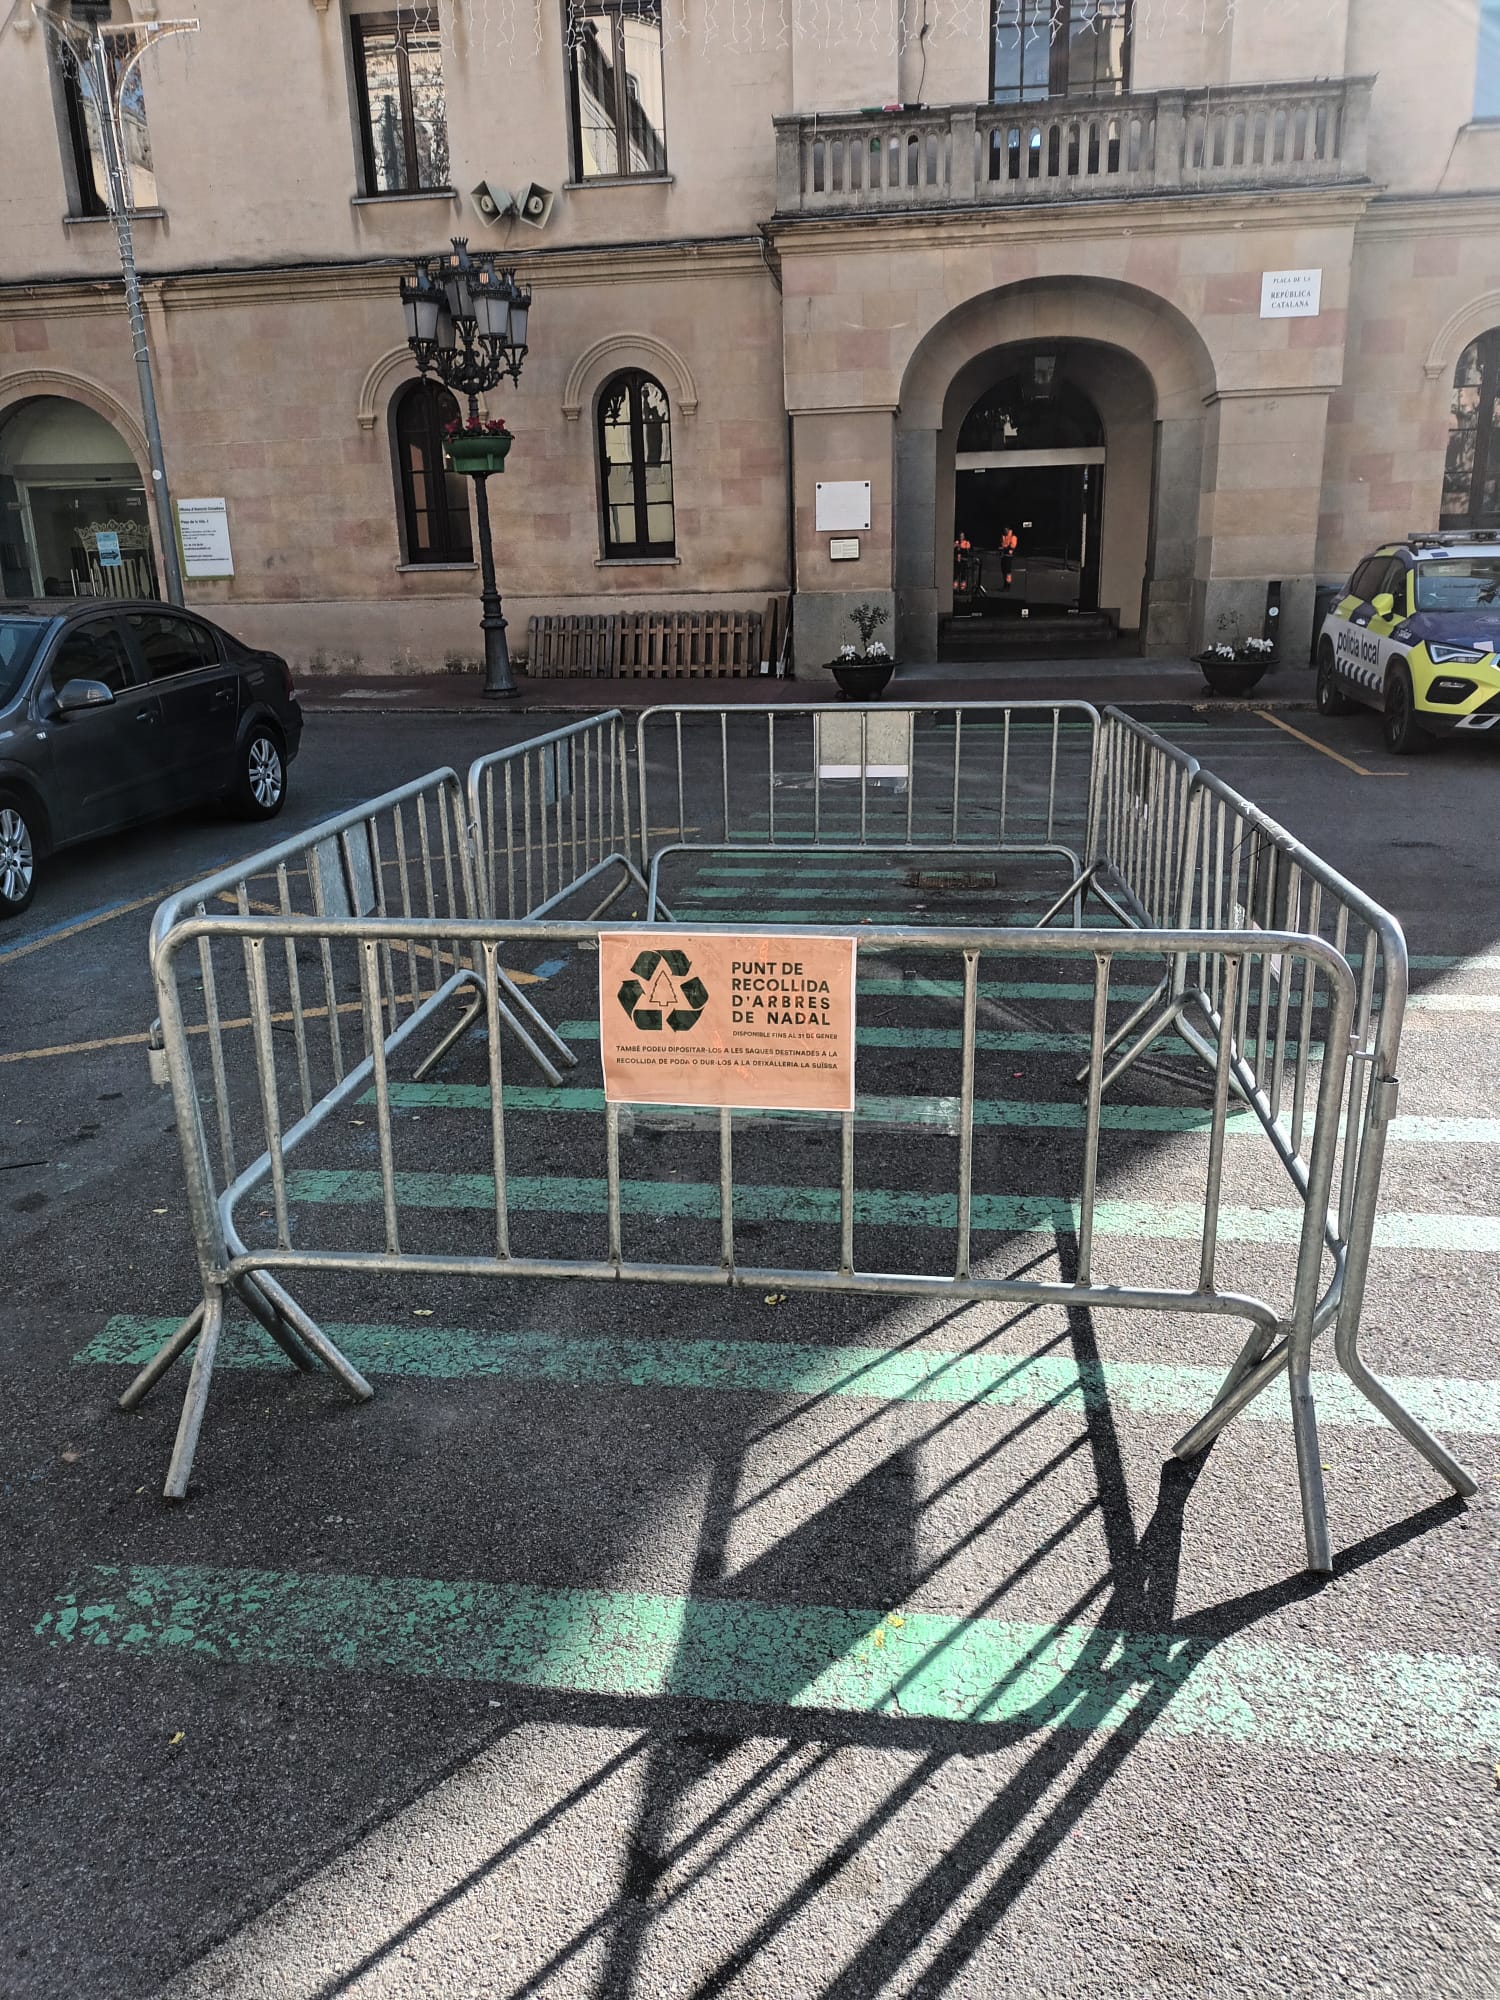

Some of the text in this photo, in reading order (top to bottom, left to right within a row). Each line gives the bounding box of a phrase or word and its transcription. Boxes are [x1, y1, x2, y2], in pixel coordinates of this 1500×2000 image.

[1271, 289, 1311, 299] REPÚBLICA
[1271, 300, 1309, 308] CATALANA
[1361, 633, 1381, 665] local
[732, 961, 803, 976] PUNT DE
[732, 978, 830, 993] RECOLLIDA
[732, 994, 830, 1010] D'ARBRES
[732, 1010, 831, 1026] DE NADAL
[732, 1030, 770, 1038] DISPONIBLE
[616, 1044, 641, 1052] TAMBÉ
[642, 1045, 667, 1053] PODEU
[668, 1046, 722, 1054] DIPOSITAR-LOS
[775, 1049, 820, 1057] DESTINADES
[616, 1057, 656, 1065] RECOLLIDA
[700, 1059, 732, 1067] DUR-LOS
[752, 1060, 799, 1068] DEIXALLERIA
